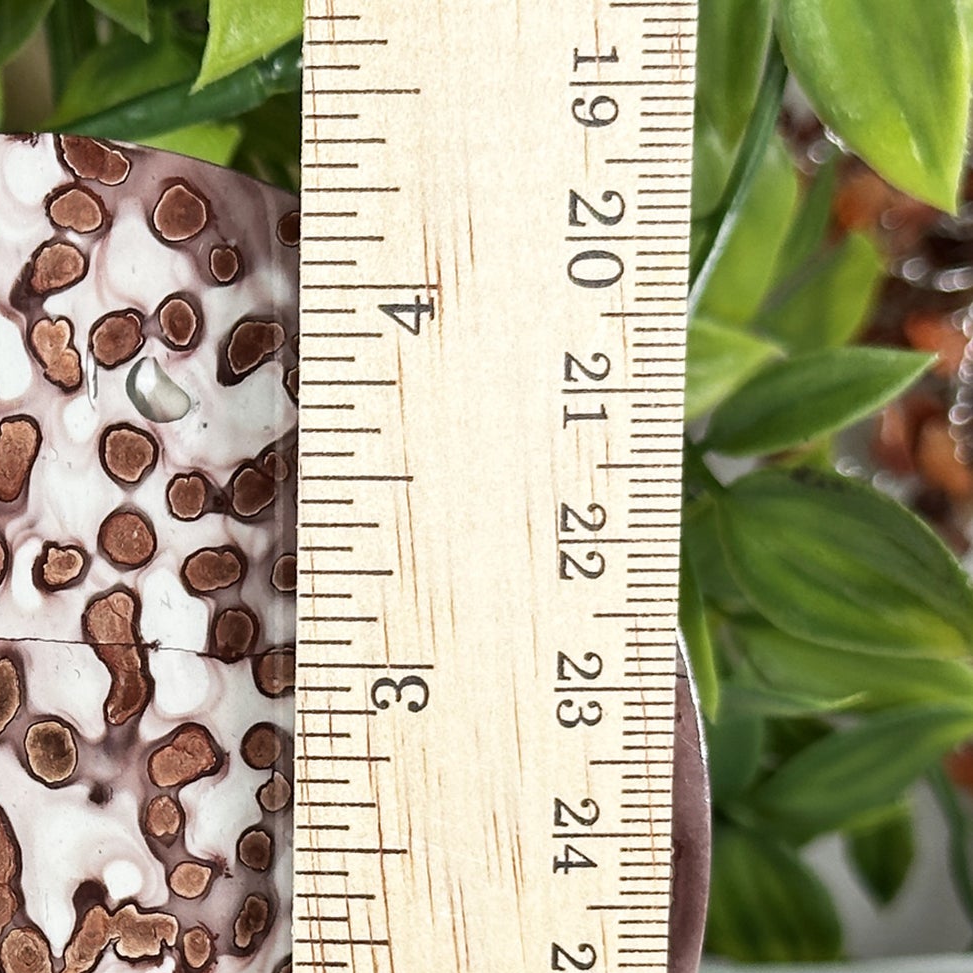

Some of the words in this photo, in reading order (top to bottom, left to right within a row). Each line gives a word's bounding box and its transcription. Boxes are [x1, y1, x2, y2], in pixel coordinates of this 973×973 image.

[572, 46, 620, 127] 19
[567, 188, 626, 289] 20
[377, 294, 435, 336] 4
[563, 352, 611, 429] 21
[560, 503, 607, 580] 22
[370, 675, 430, 713] 3
[556, 651, 603, 729] 23
[553, 797, 600, 875] 24
